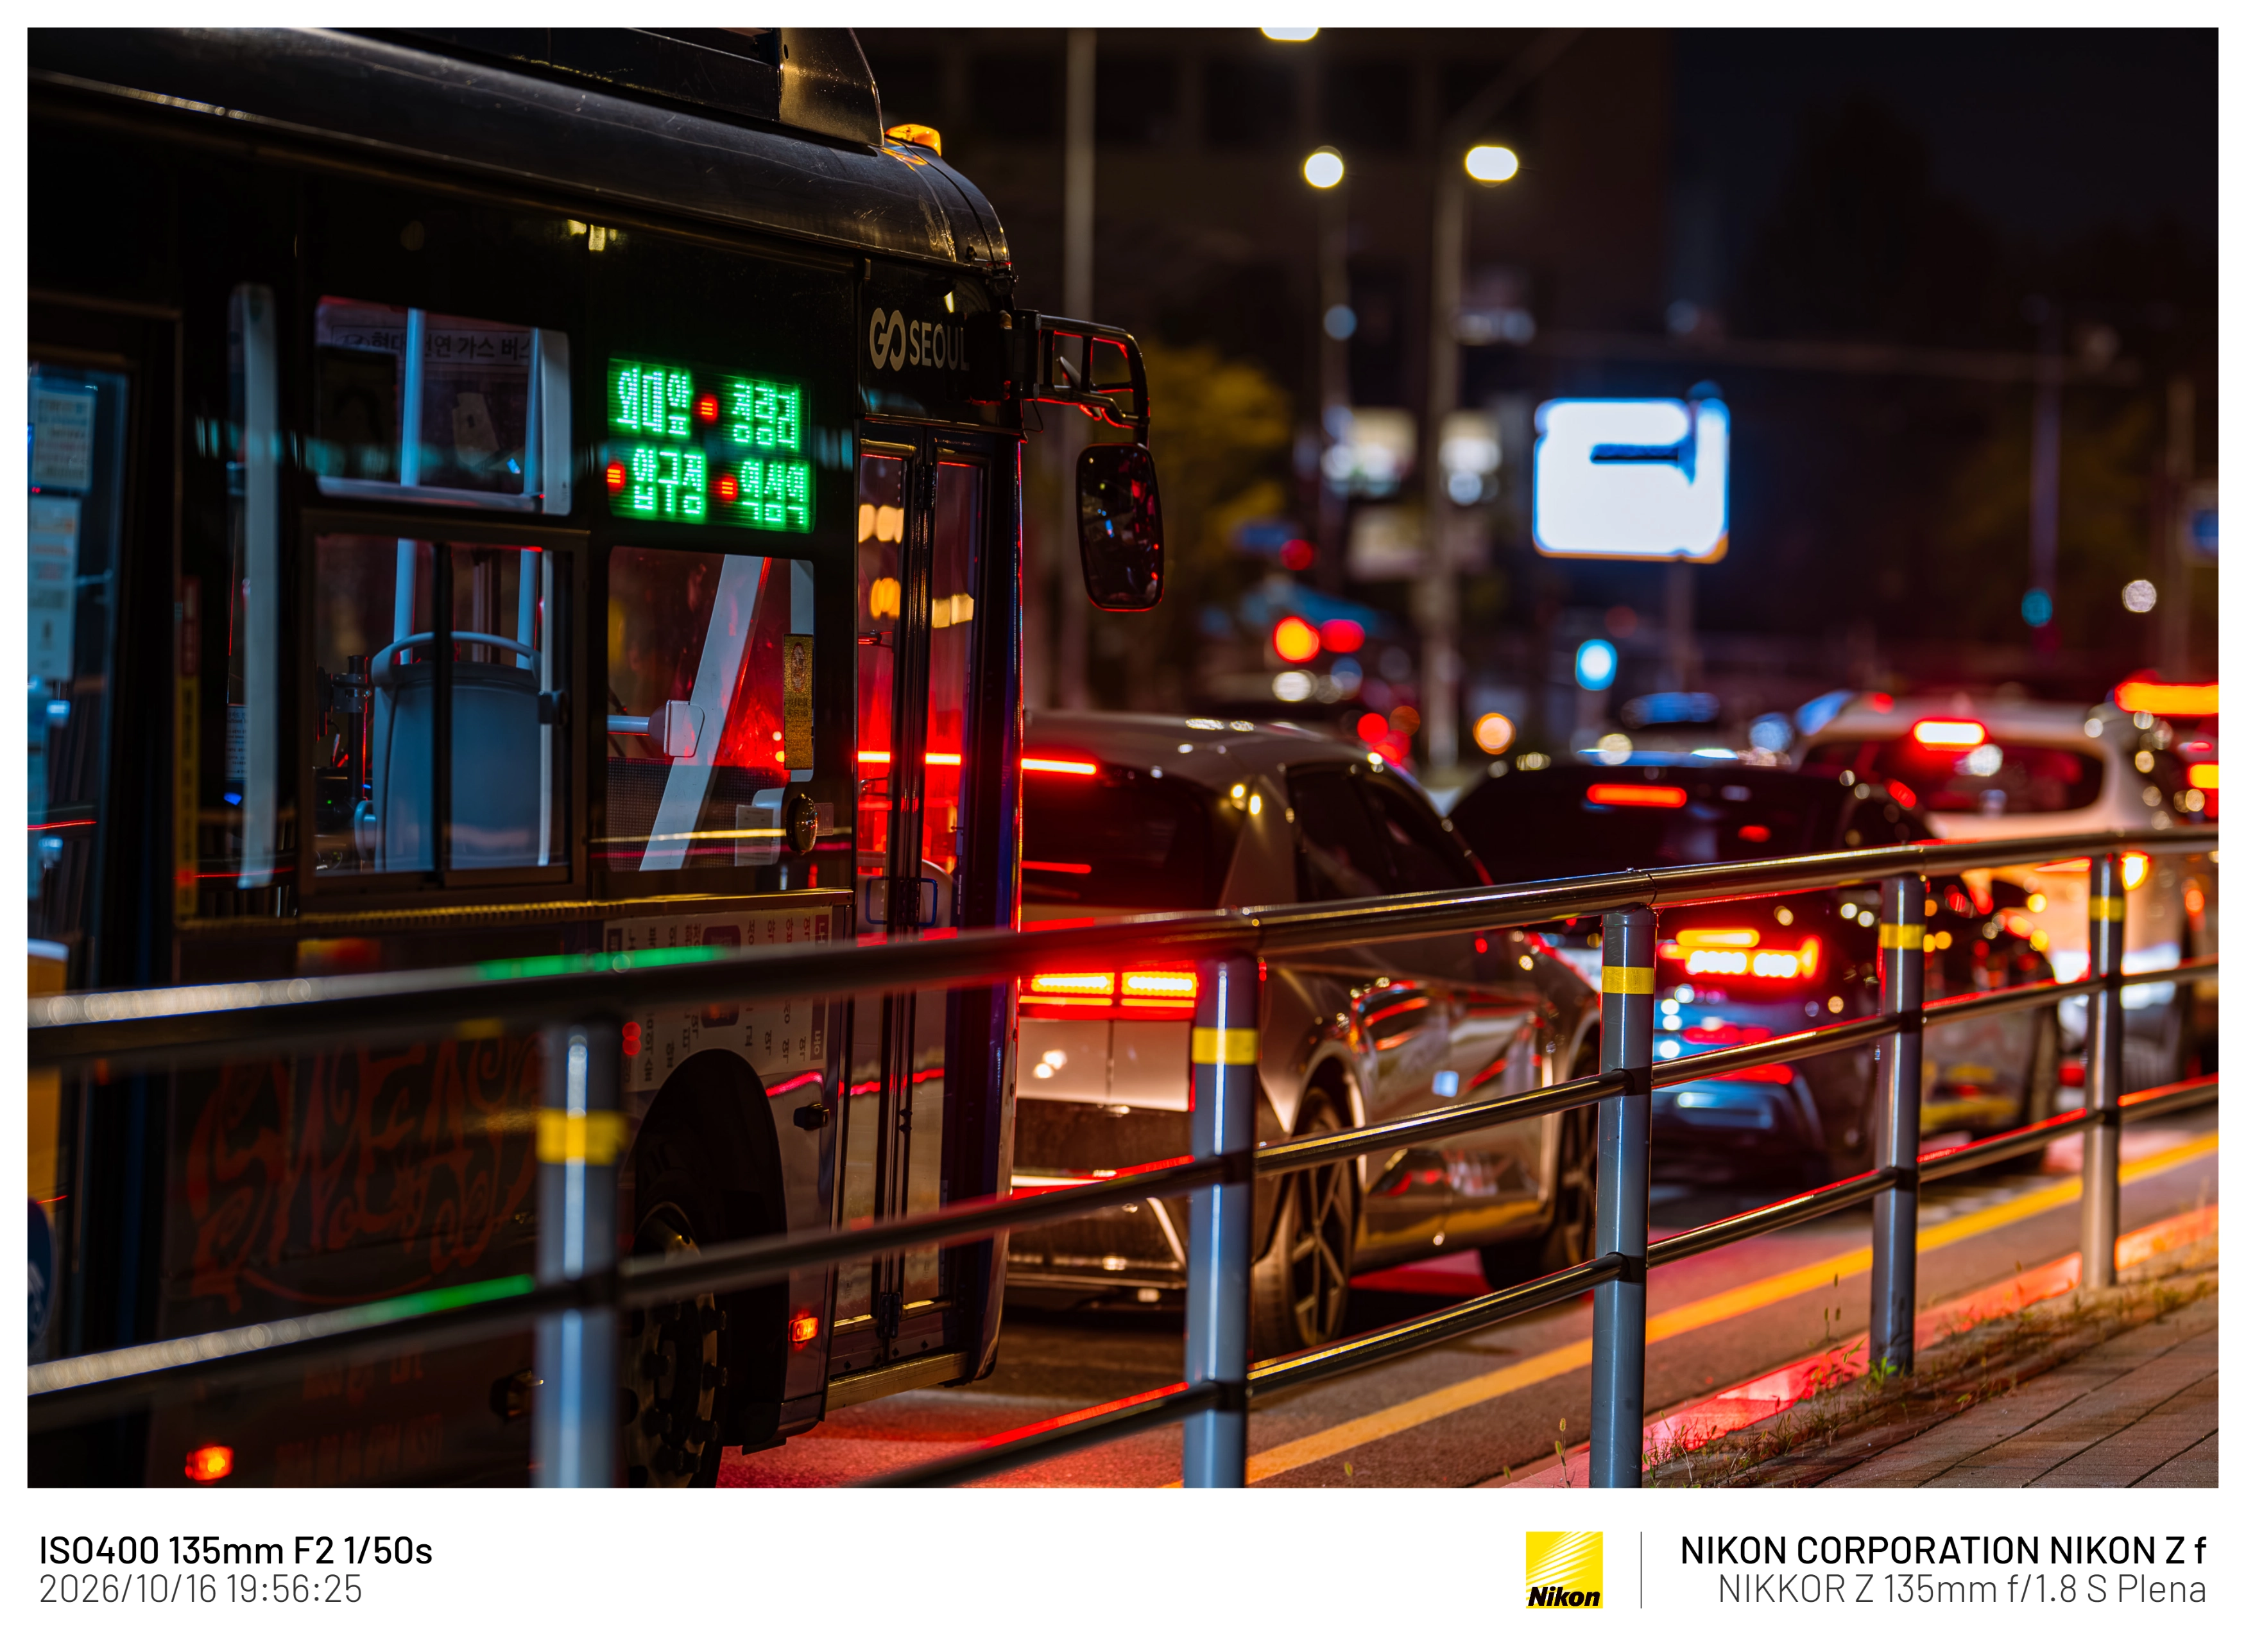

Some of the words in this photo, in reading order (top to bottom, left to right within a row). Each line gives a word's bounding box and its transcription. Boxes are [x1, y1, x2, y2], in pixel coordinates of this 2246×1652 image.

[458, 336, 495, 360] 가스
[870, 307, 907, 372] GO
[909, 320, 970, 372] SEOUL
[617, 367, 690, 436] 외대앞
[732, 383, 796, 450] 청량리
[632, 447, 703, 515] 압구정
[739, 460, 805, 525] 역삼역
